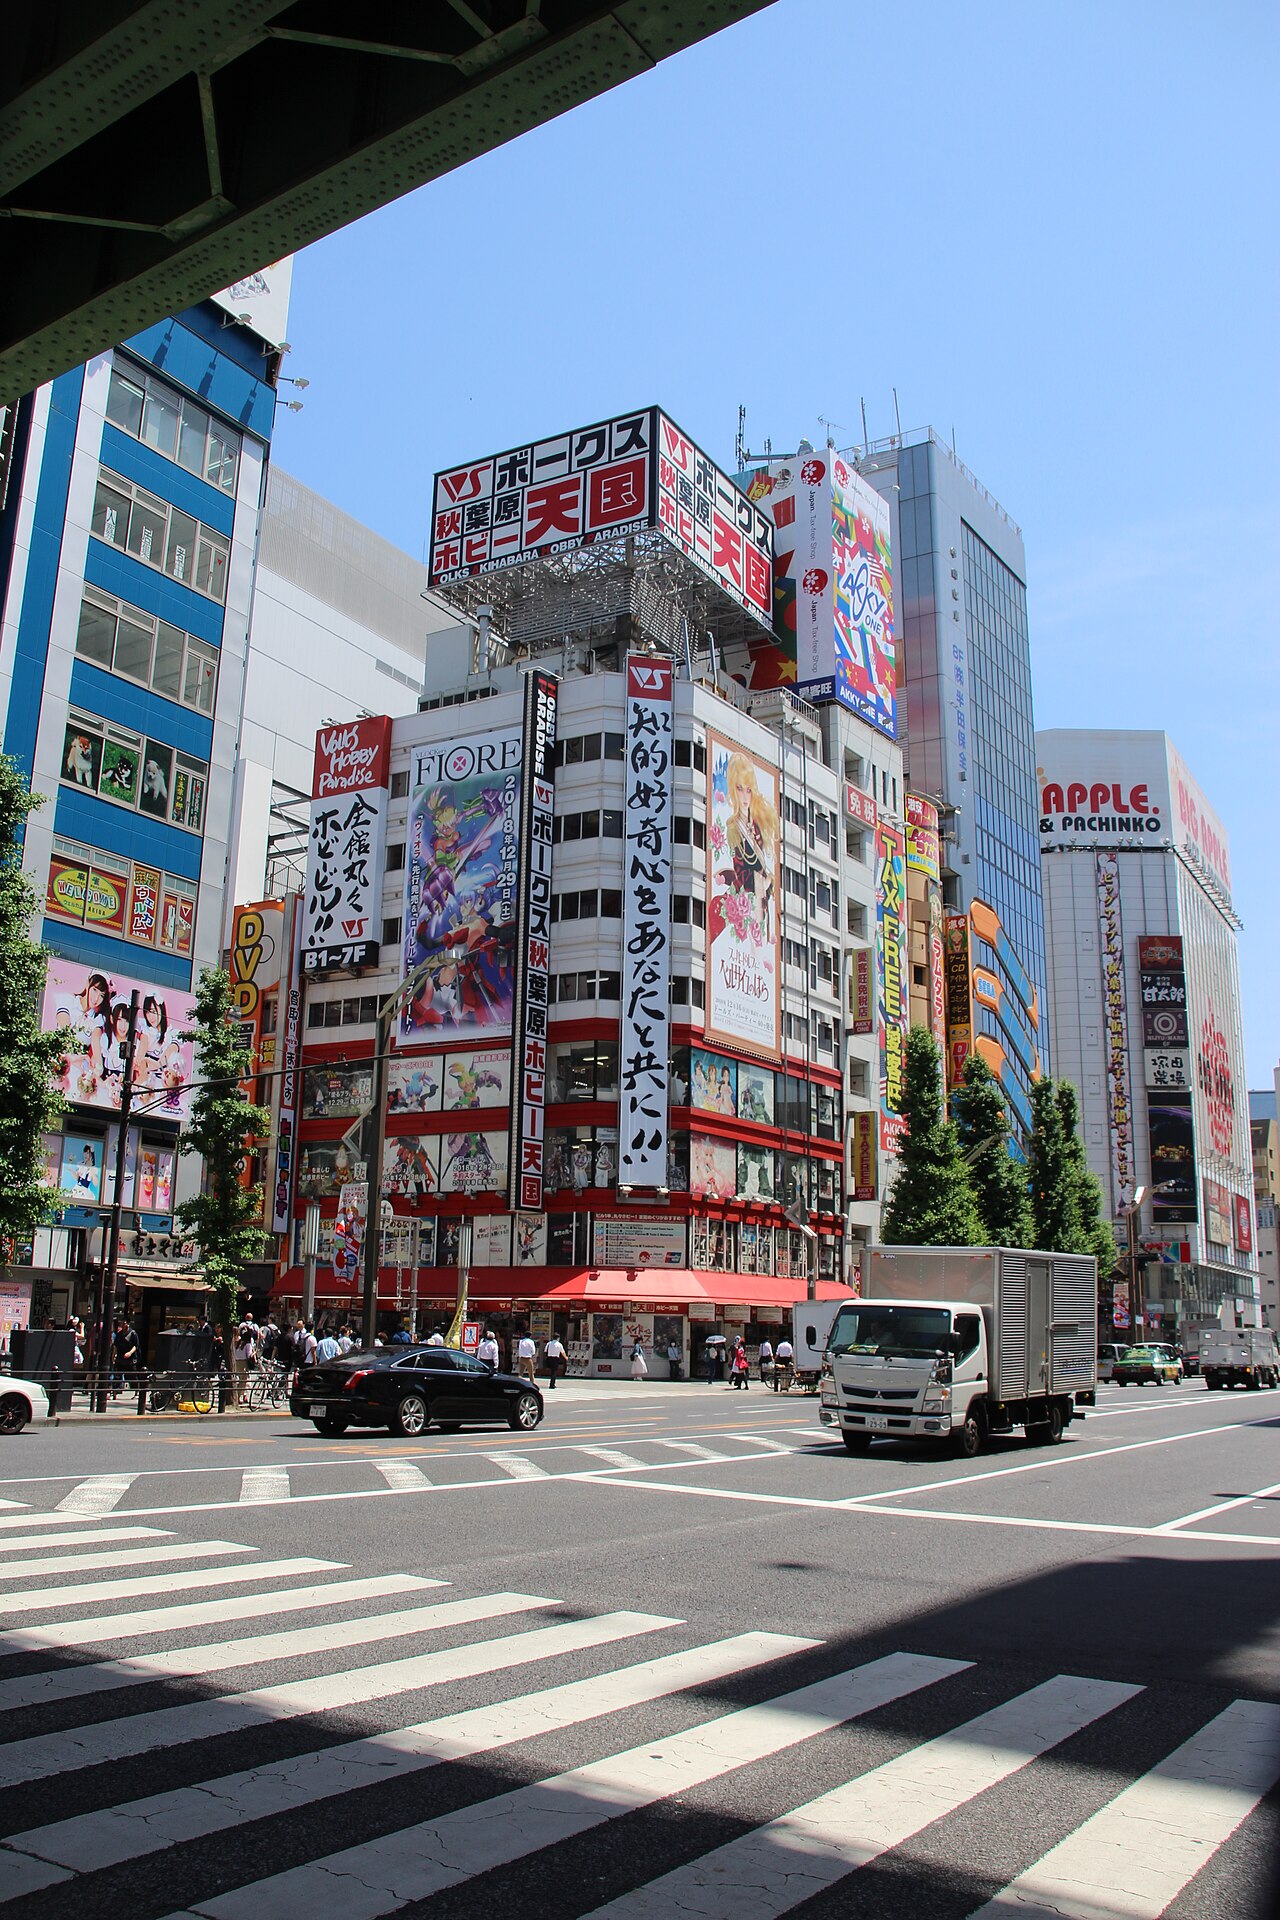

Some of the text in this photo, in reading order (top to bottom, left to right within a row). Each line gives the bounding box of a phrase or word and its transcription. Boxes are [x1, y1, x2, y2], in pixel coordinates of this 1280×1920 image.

[497, 417, 647, 491] ボークス
[434, 457, 646, 571] ホビー 天国
[660, 457, 710, 527] 秋葉原
[697, 460, 771, 554] ボークス
[436, 494, 521, 540] 秋葉原
[433, 519, 649, 585] VOLKS AKIHABARA HOBBY PARADISE
[660, 495, 771, 613] ホビー 天国
[660, 521, 683, 549] VOLKS
[684, 544, 722, 586] AKIHABARA
[722, 578, 744, 604] HOBBY
[842, 572, 885, 616] AKKY
[865, 614, 882, 635] ONE
[811, 655, 819, 673] Shop
[546, 683, 556, 749] HOBBY
[839, 685, 861, 708] AKKY
[535, 677, 547, 775] PARADISE
[318, 766, 376, 797] Paradise
[414, 738, 523, 787] FIORE
[850, 791, 875, 824] 免税
[1039, 816, 1161, 833] & PACHINKO
[1178, 779, 1199, 842] BIG
[57, 880, 116, 909] WELCOME
[88, 906, 106, 917] AKIBA
[132, 886, 155, 930] ウェルカム
[132, 930, 150, 940] AKIBA
[881, 832, 901, 1017] TAX FREE
[233, 912, 264, 1017] DVD
[951, 964, 965, 973] CD
[950, 984, 968, 992] アニメ
[978, 976, 996, 999] SEGA
[1142, 986, 1185, 1003] 甘太郎
[132, 1235, 184, 1258] 富士そば
[183, 1242, 195, 1253] 24
